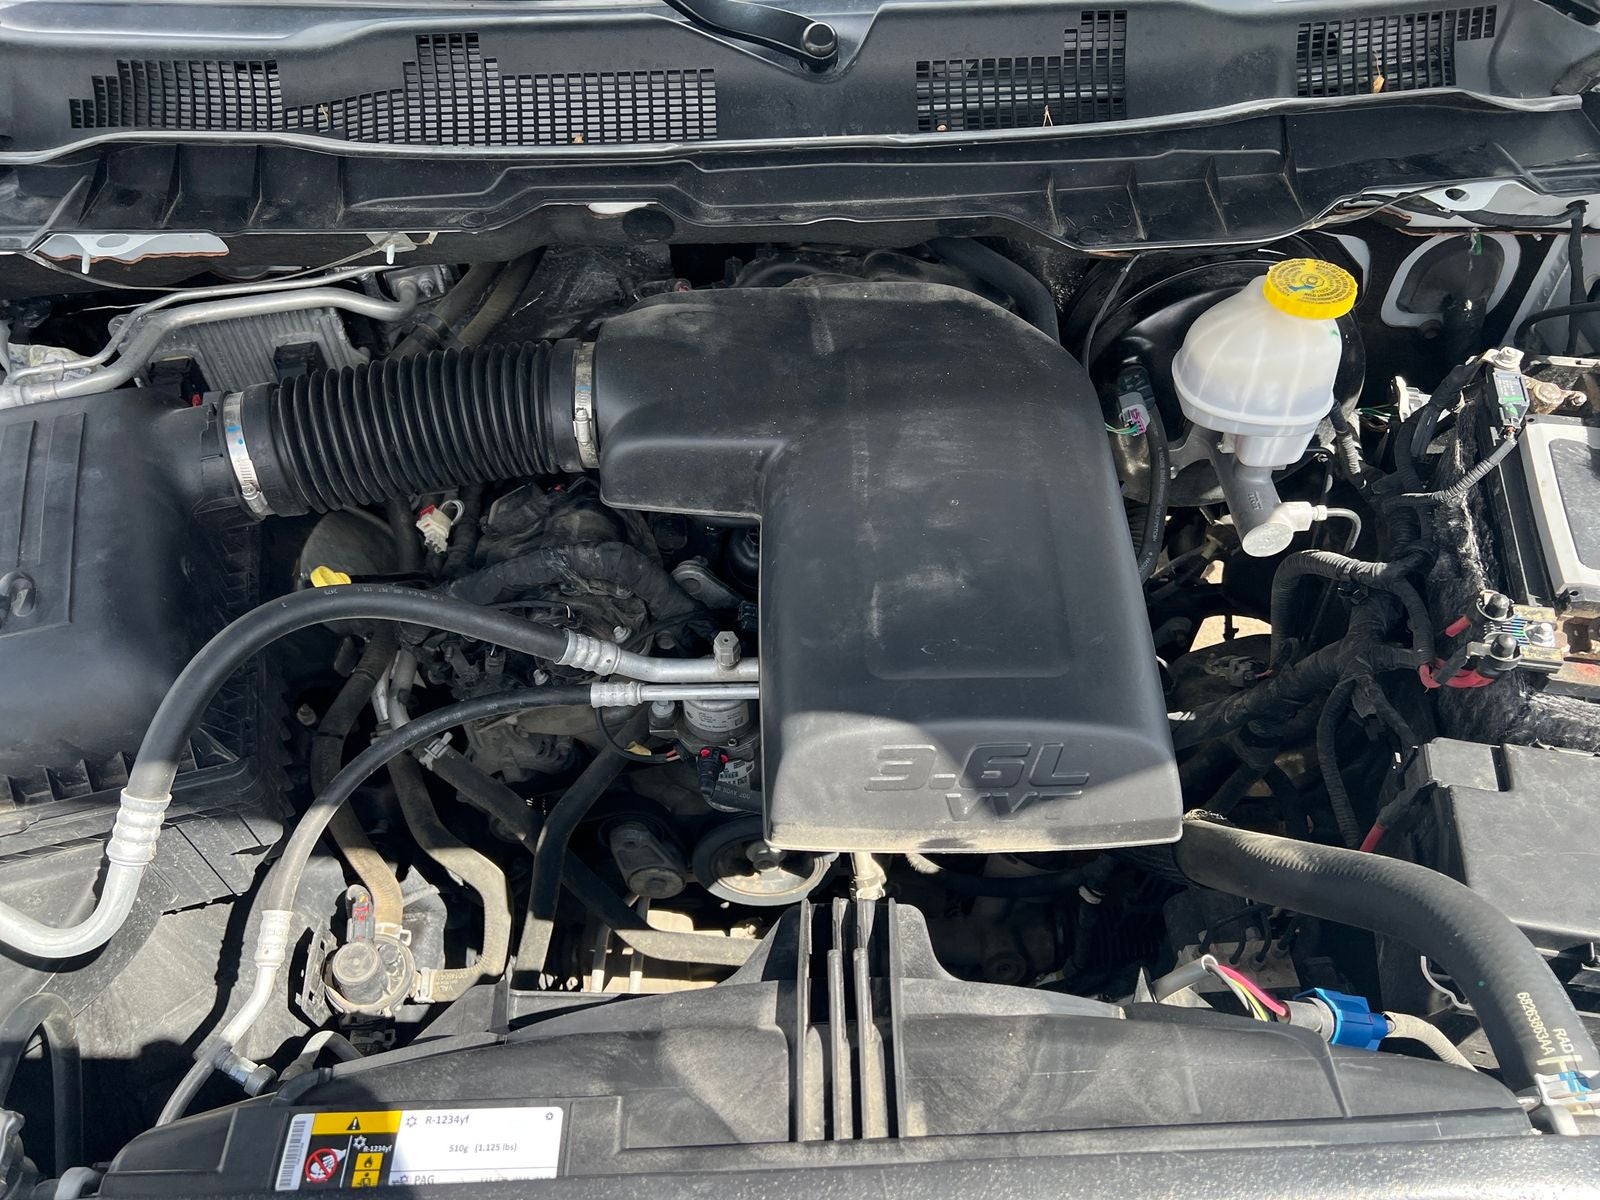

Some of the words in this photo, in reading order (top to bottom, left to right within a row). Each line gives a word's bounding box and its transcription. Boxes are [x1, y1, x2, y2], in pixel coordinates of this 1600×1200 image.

[864, 741, 1090, 792] 3.6L
[945, 789, 1083, 823] VVT
[1552, 1028, 1575, 1054] RAD
[425, 1114, 470, 1126] R-1234yf
[448, 1143, 469, 1154] 510g
[474, 1142, 500, 1153] (1.125
[500, 1141, 518, 1153] lbs)
[414, 1174, 435, 1186] PAG
